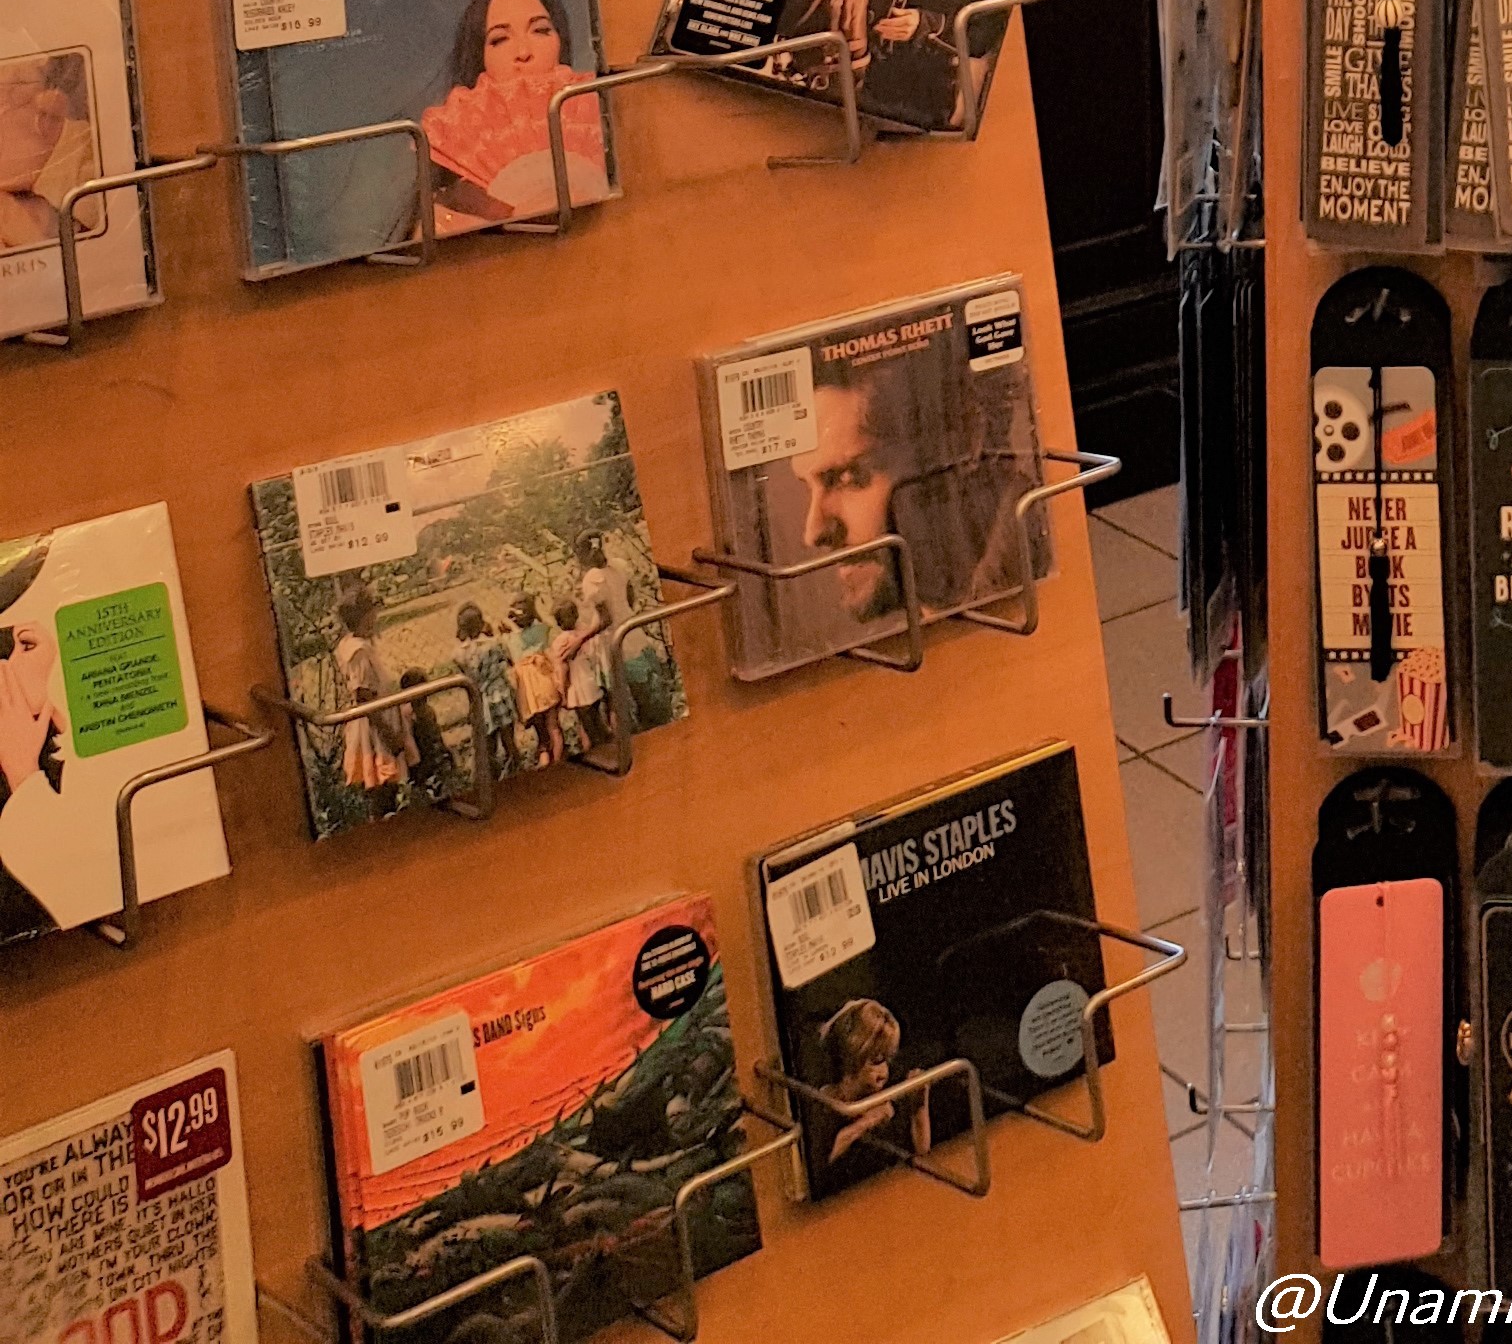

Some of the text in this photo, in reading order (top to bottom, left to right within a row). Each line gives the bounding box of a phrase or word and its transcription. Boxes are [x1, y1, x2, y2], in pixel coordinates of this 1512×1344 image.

[821, 327, 898, 363] THOMAS
[900, 309, 953, 340] RHETT
[66, 607, 161, 642] ANNIVERSARY
[88, 626, 145, 650] EDITION
[923, 799, 1017, 866] STAPLES
[879, 841, 995, 903] LIVE IN LONDON
[514, 1005, 546, 1033] Signs
[141, 1087, 218, 1159] $12.99
